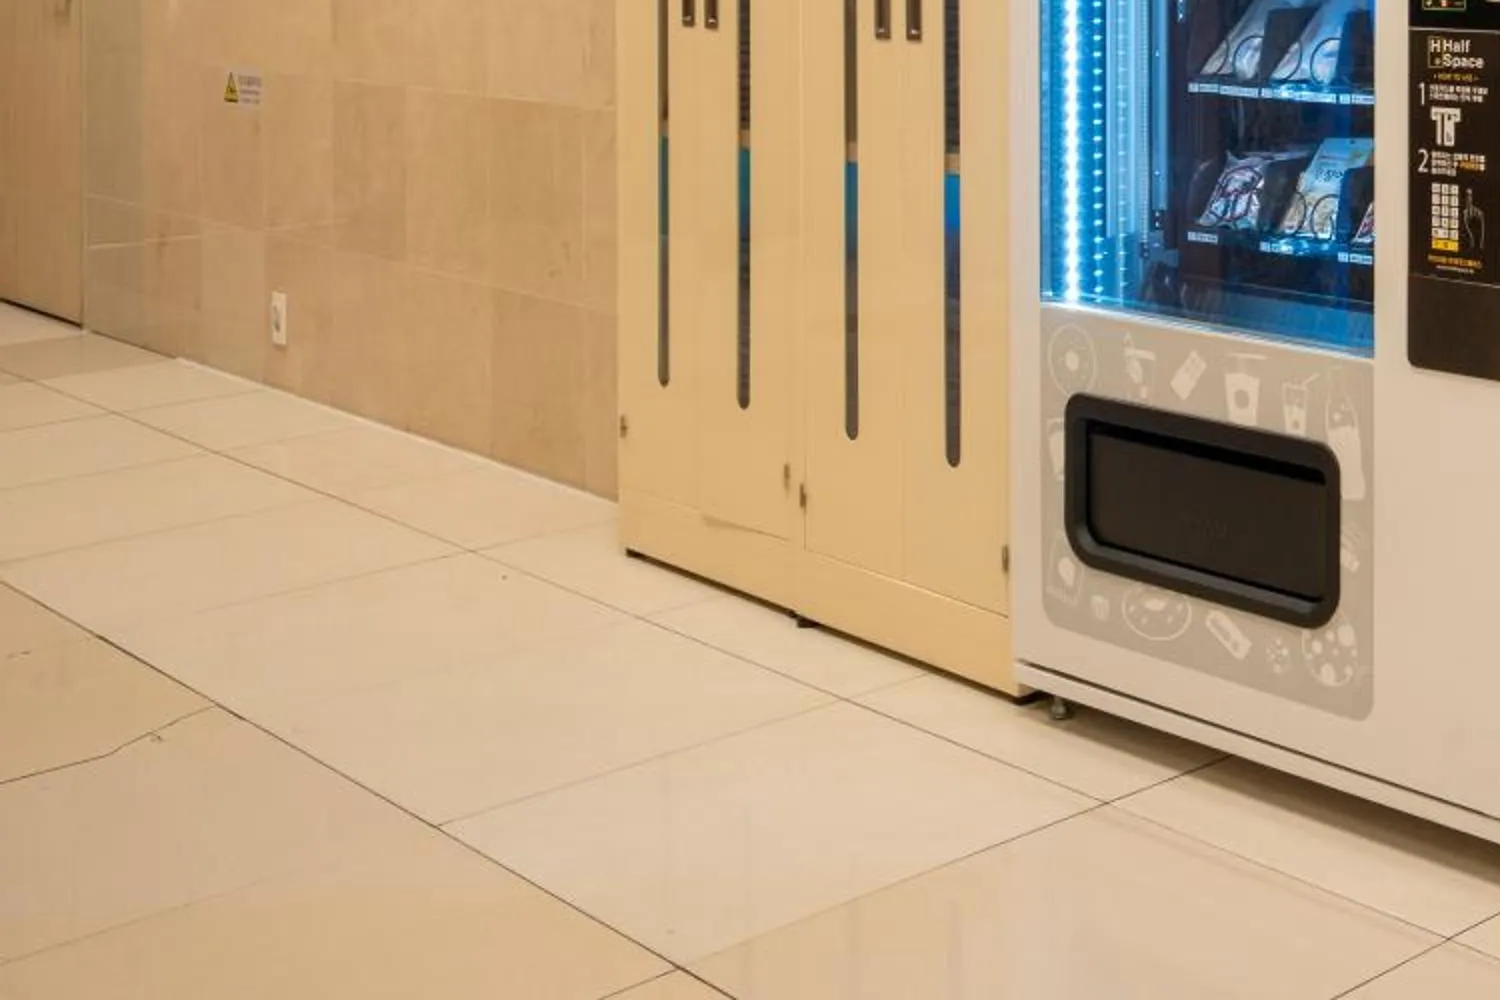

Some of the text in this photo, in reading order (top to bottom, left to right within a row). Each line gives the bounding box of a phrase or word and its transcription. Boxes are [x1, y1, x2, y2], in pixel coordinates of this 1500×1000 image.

[1442, 39, 1471, 53] Half
[1442, 53, 1485, 69] Space
[1418, 82, 1426, 106] 1
[1417, 148, 1429, 173] 2
